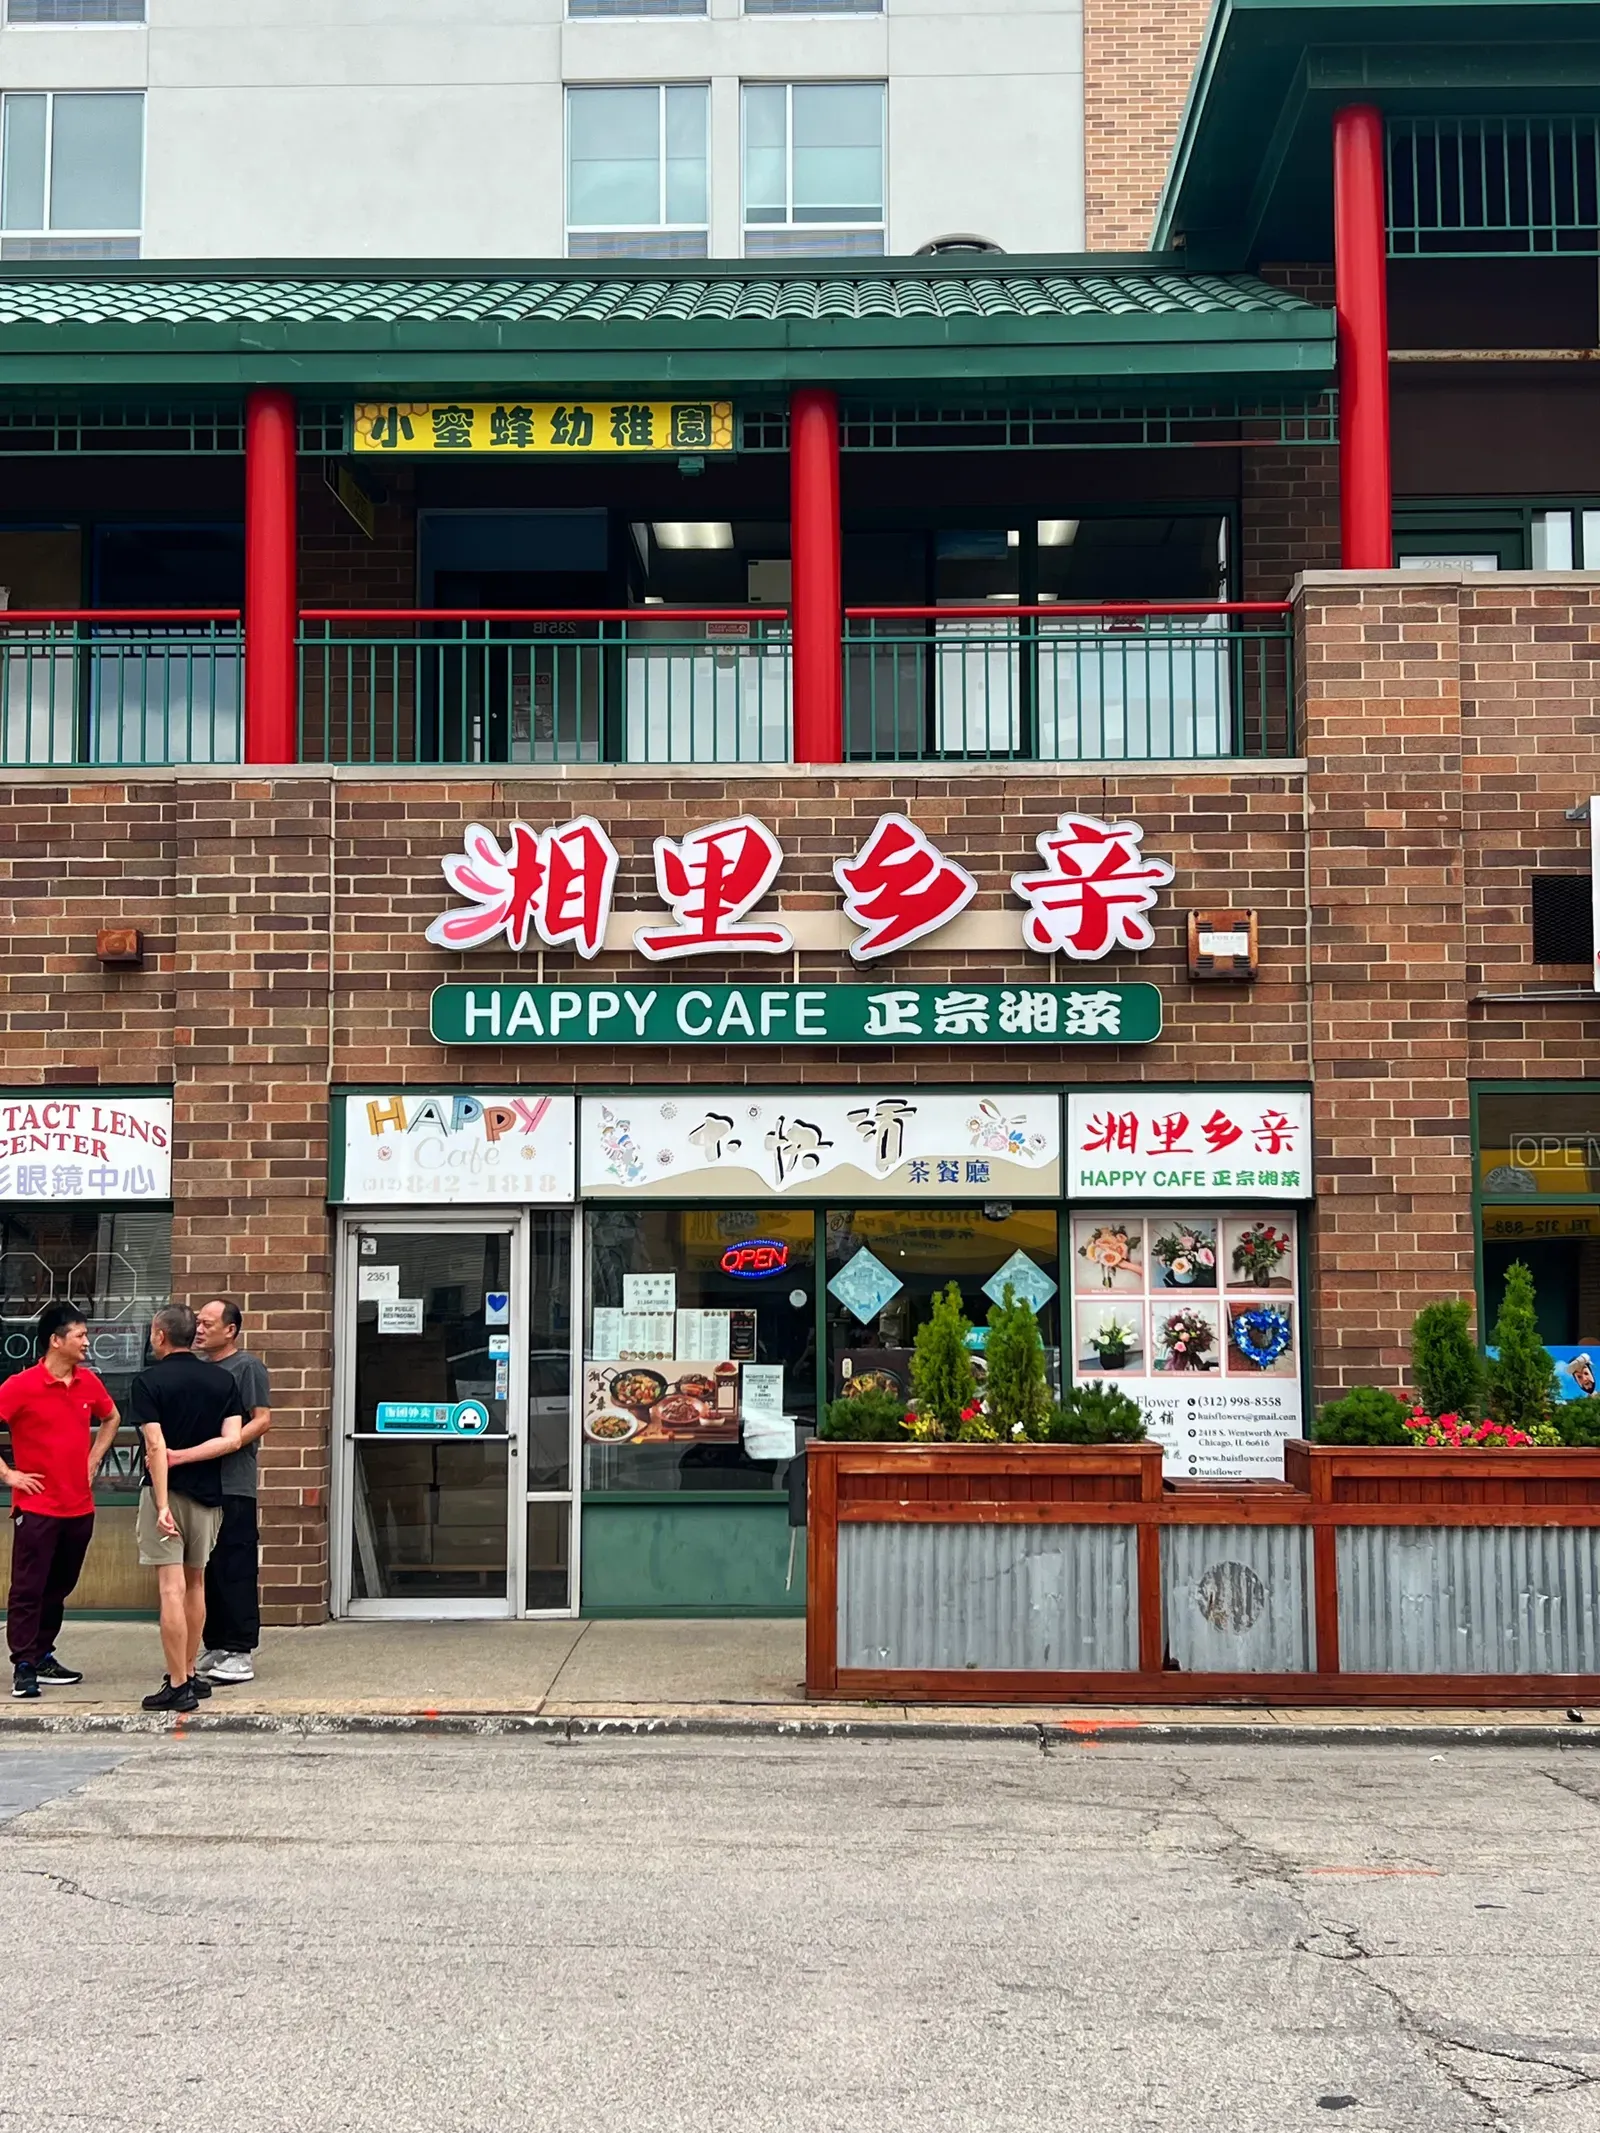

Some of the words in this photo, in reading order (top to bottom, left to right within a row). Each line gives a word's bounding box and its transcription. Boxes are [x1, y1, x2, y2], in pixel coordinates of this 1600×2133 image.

[370, 403, 713, 449] 小蜜蜂幼稚園
[430, 814, 1174, 961] 湘里乡亲
[464, 990, 658, 1037] HAPPY
[676, 990, 828, 1037] CAFE
[863, 990, 1123, 1036] 正宗湘菜
[0, 1103, 81, 1132] TACT
[91, 1106, 167, 1148] LENS
[366, 1095, 553, 1144] HAPPY
[1080, 1109, 1299, 1155] 湘里乡亲
[414, 1136, 501, 1175] Cafe
[907, 1159, 991, 1184] 茶餐廳
[1080, 1170, 1147, 1187] HAPPY
[1153, 1170, 1206, 1187] CAFE
[720, 1245, 789, 1272] OPEN
[366, 1272, 391, 1281] 2351
[1136, 1395, 1180, 1408] Flower
[1197, 1395, 1227, 1408] (312)
[1230, 1396, 1282, 1407] 998-8558
[1228, 1429, 1272, 1437] Wentworth
